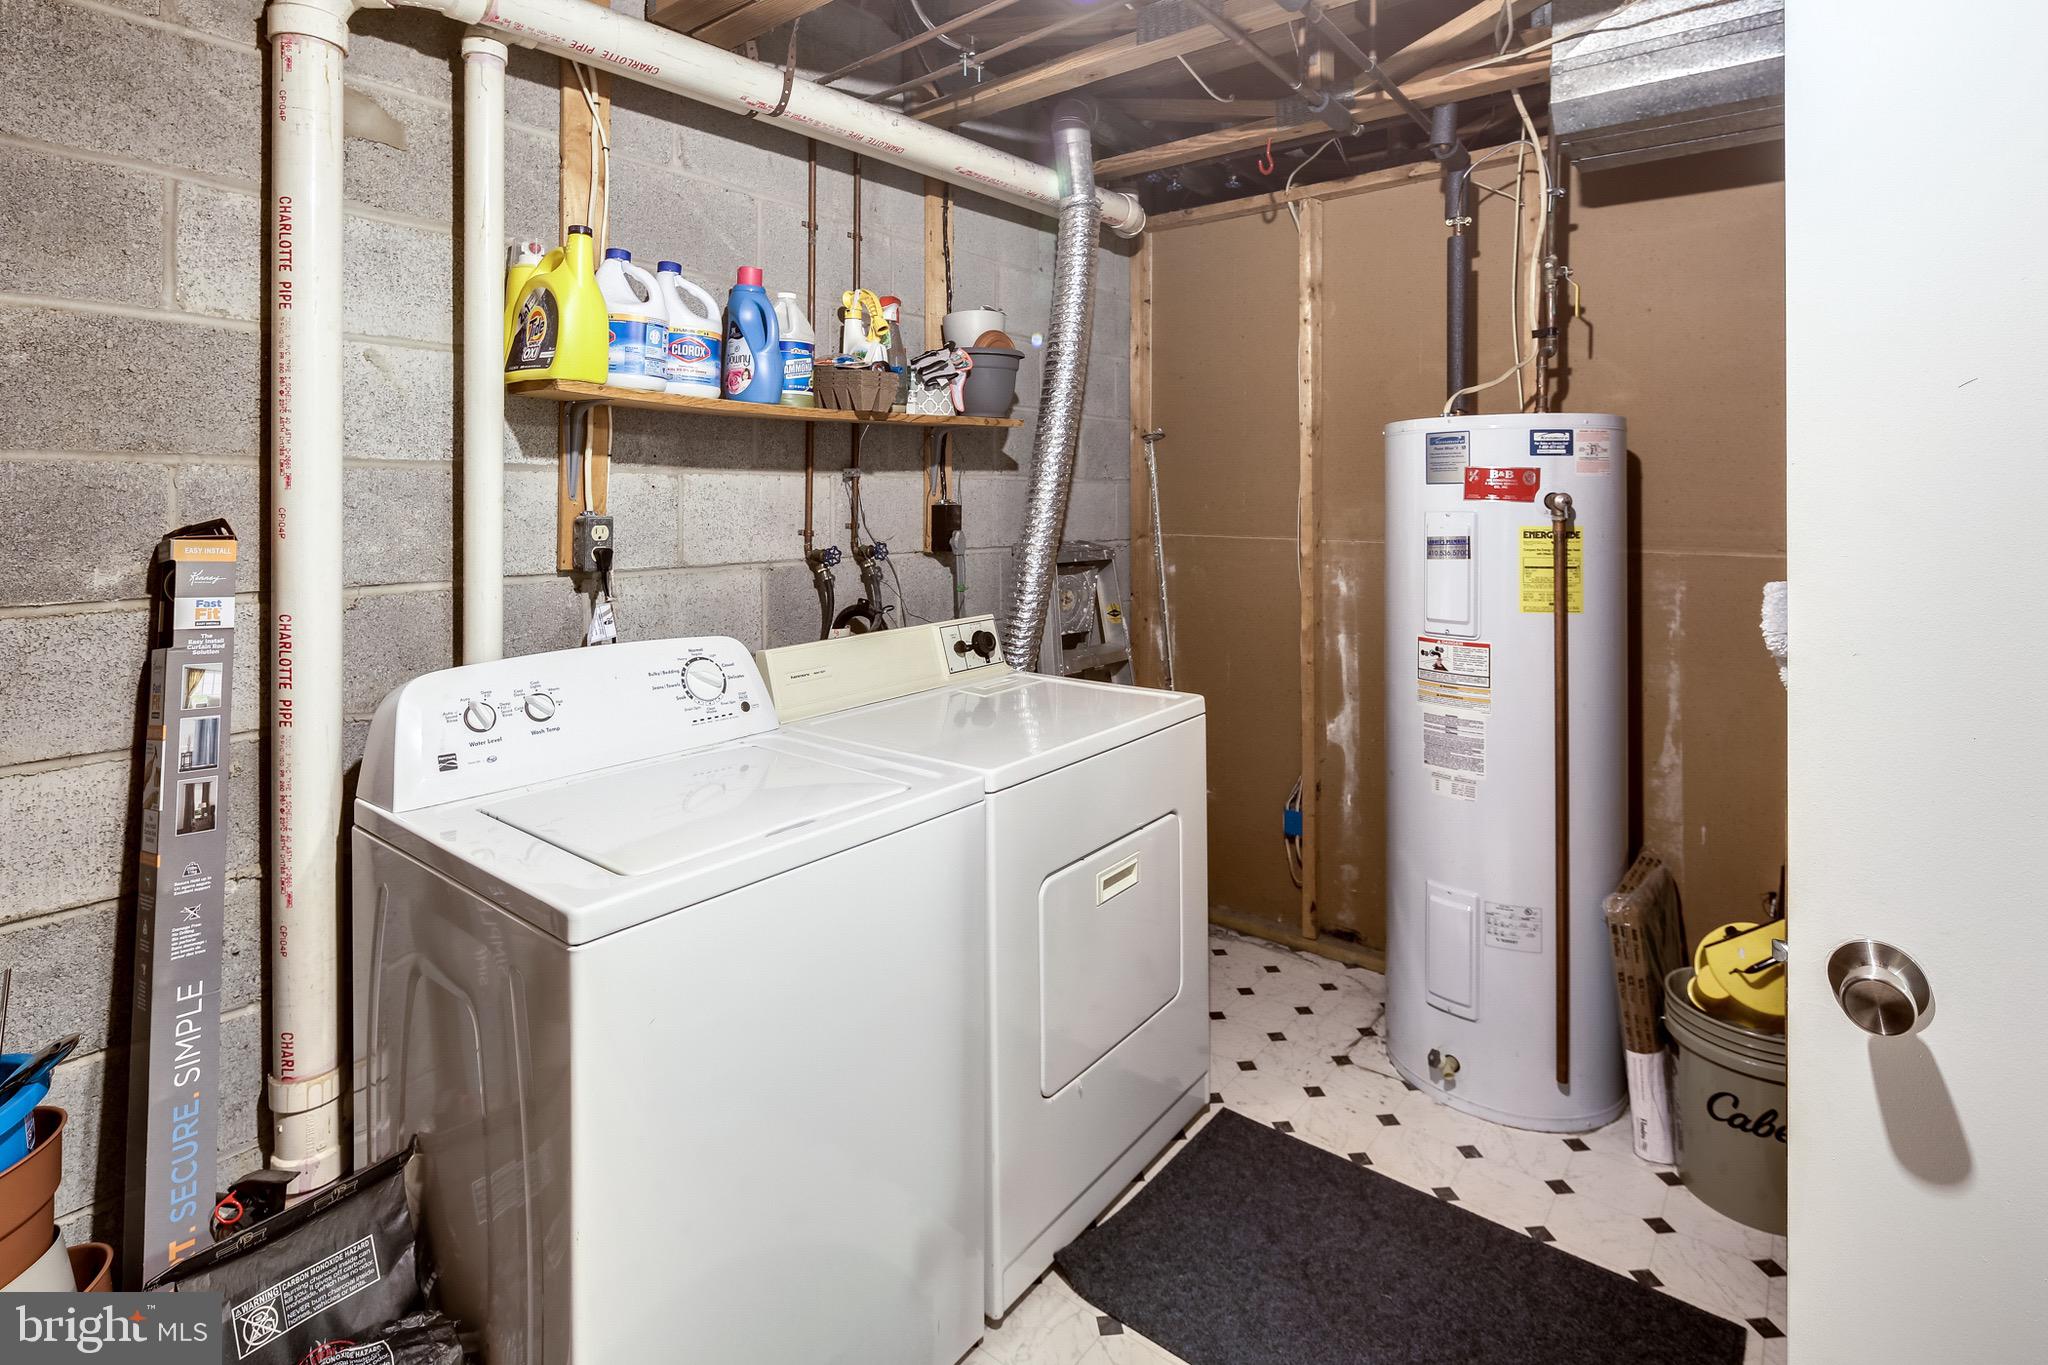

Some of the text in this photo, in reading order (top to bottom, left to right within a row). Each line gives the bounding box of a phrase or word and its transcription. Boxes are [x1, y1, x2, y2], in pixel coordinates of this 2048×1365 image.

[569, 39, 660, 76] CHARLOTTE PIPE
[279, 90, 287, 122] CP104P
[847, 130, 905, 155] CHARLOTTE PIPE
[279, 196, 292, 310] CHARLOTTE PIPE
[528, 316, 545, 338] Tide
[523, 348, 538, 360] OXI
[671, 344, 706, 357] CLOROX
[278, 507, 286, 540] CP104P
[194, 607, 221, 620] Fit
[195, 600, 222, 608] Fast
[278, 614, 292, 728] CHARLOTTE PIPE
[468, 736, 502, 748] Water Level
[546, 726, 560, 734] Temp
[280, 925, 288, 958] CP104P
[174, 980, 203, 1087] SIMPLE
[170, 1091, 200, 1223] SECURE.
[282, 1239, 370, 1291] CARBON MONOXIDE HAZARD
[283, 1248, 371, 1299] Burning charcoal inside can
[314, 1274, 332, 1289] gives
[333, 1267, 343, 1279] off
[343, 1257, 367, 1274] carbon
[318, 1280, 337, 1294] which
[337, 1272, 350, 1282] has
[349, 1268, 358, 1276] no
[241, 1287, 280, 1313] WARNING
[287, 1268, 375, 1319] NEVER burn charcoal inside
[313, 1296, 341, 1312] vehicles
